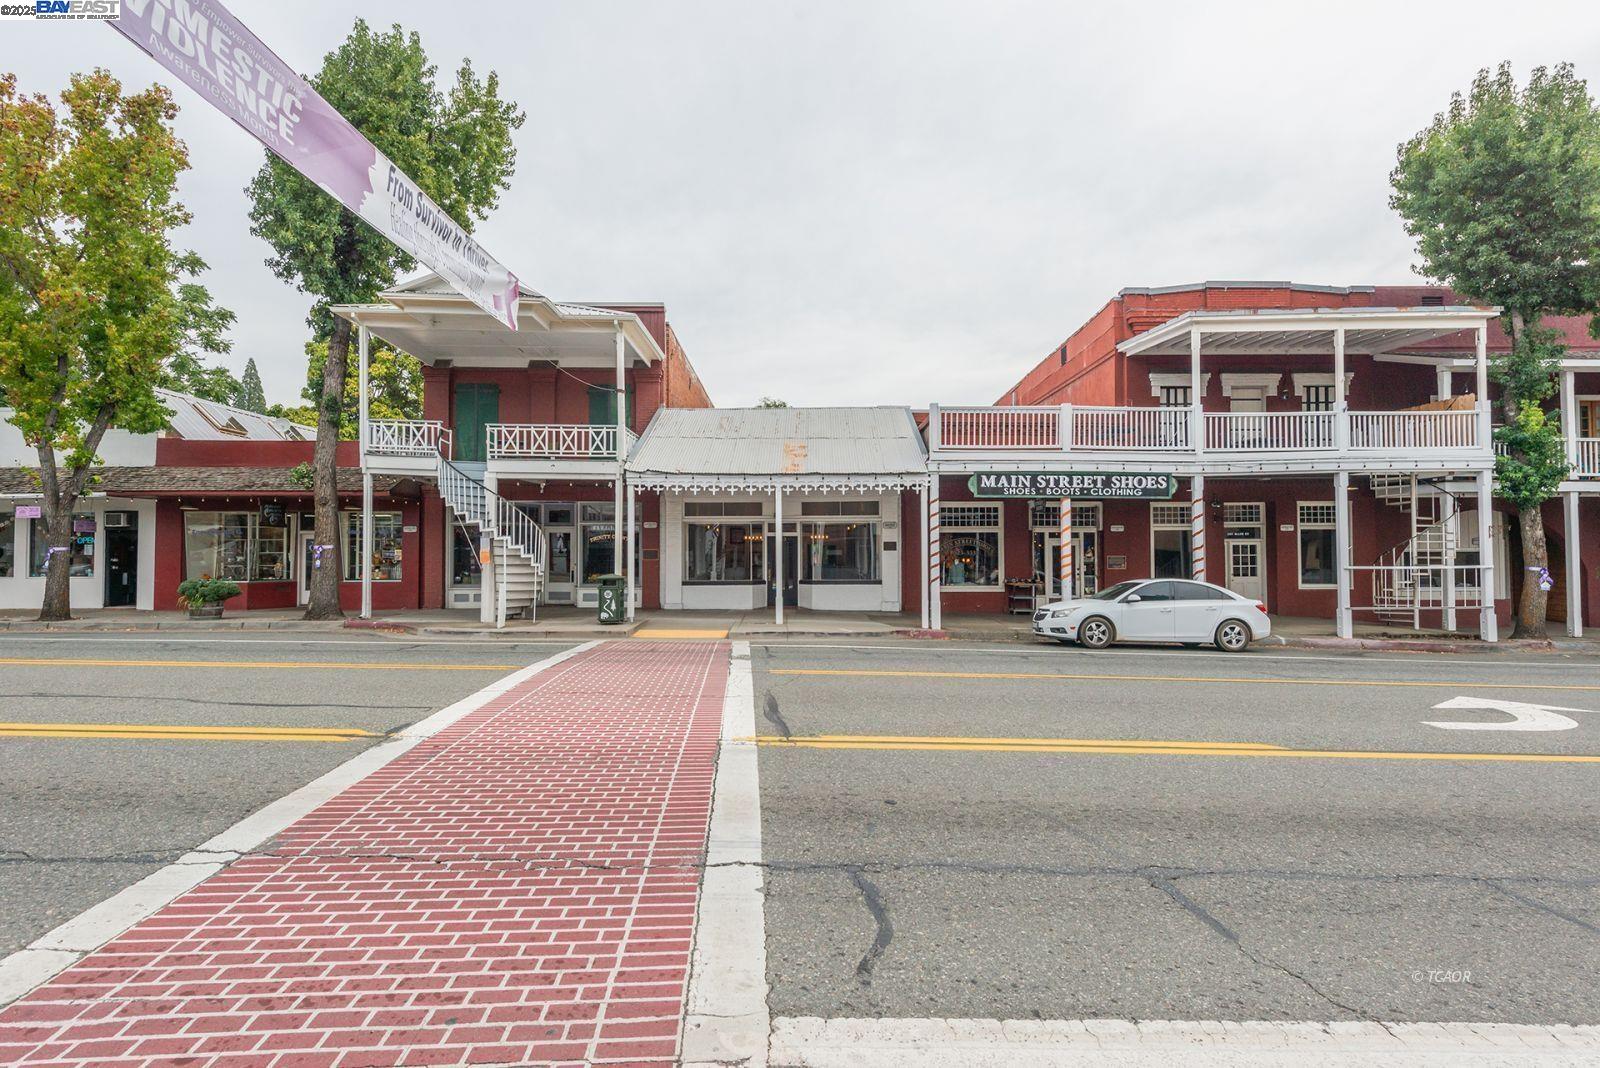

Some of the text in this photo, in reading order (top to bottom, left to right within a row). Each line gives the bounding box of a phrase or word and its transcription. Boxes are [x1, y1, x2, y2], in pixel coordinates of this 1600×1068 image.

[201, 3, 247, 46] Empower
[149, 33, 280, 147] Awareness Month
[387, 165, 413, 212] From
[415, 191, 454, 244] Survivor
[452, 228, 462, 253] to
[980, 475, 1167, 489] MAIN STREET SHOES
[1003, 487, 1142, 496] SHOES BOOTS CLOTHING
